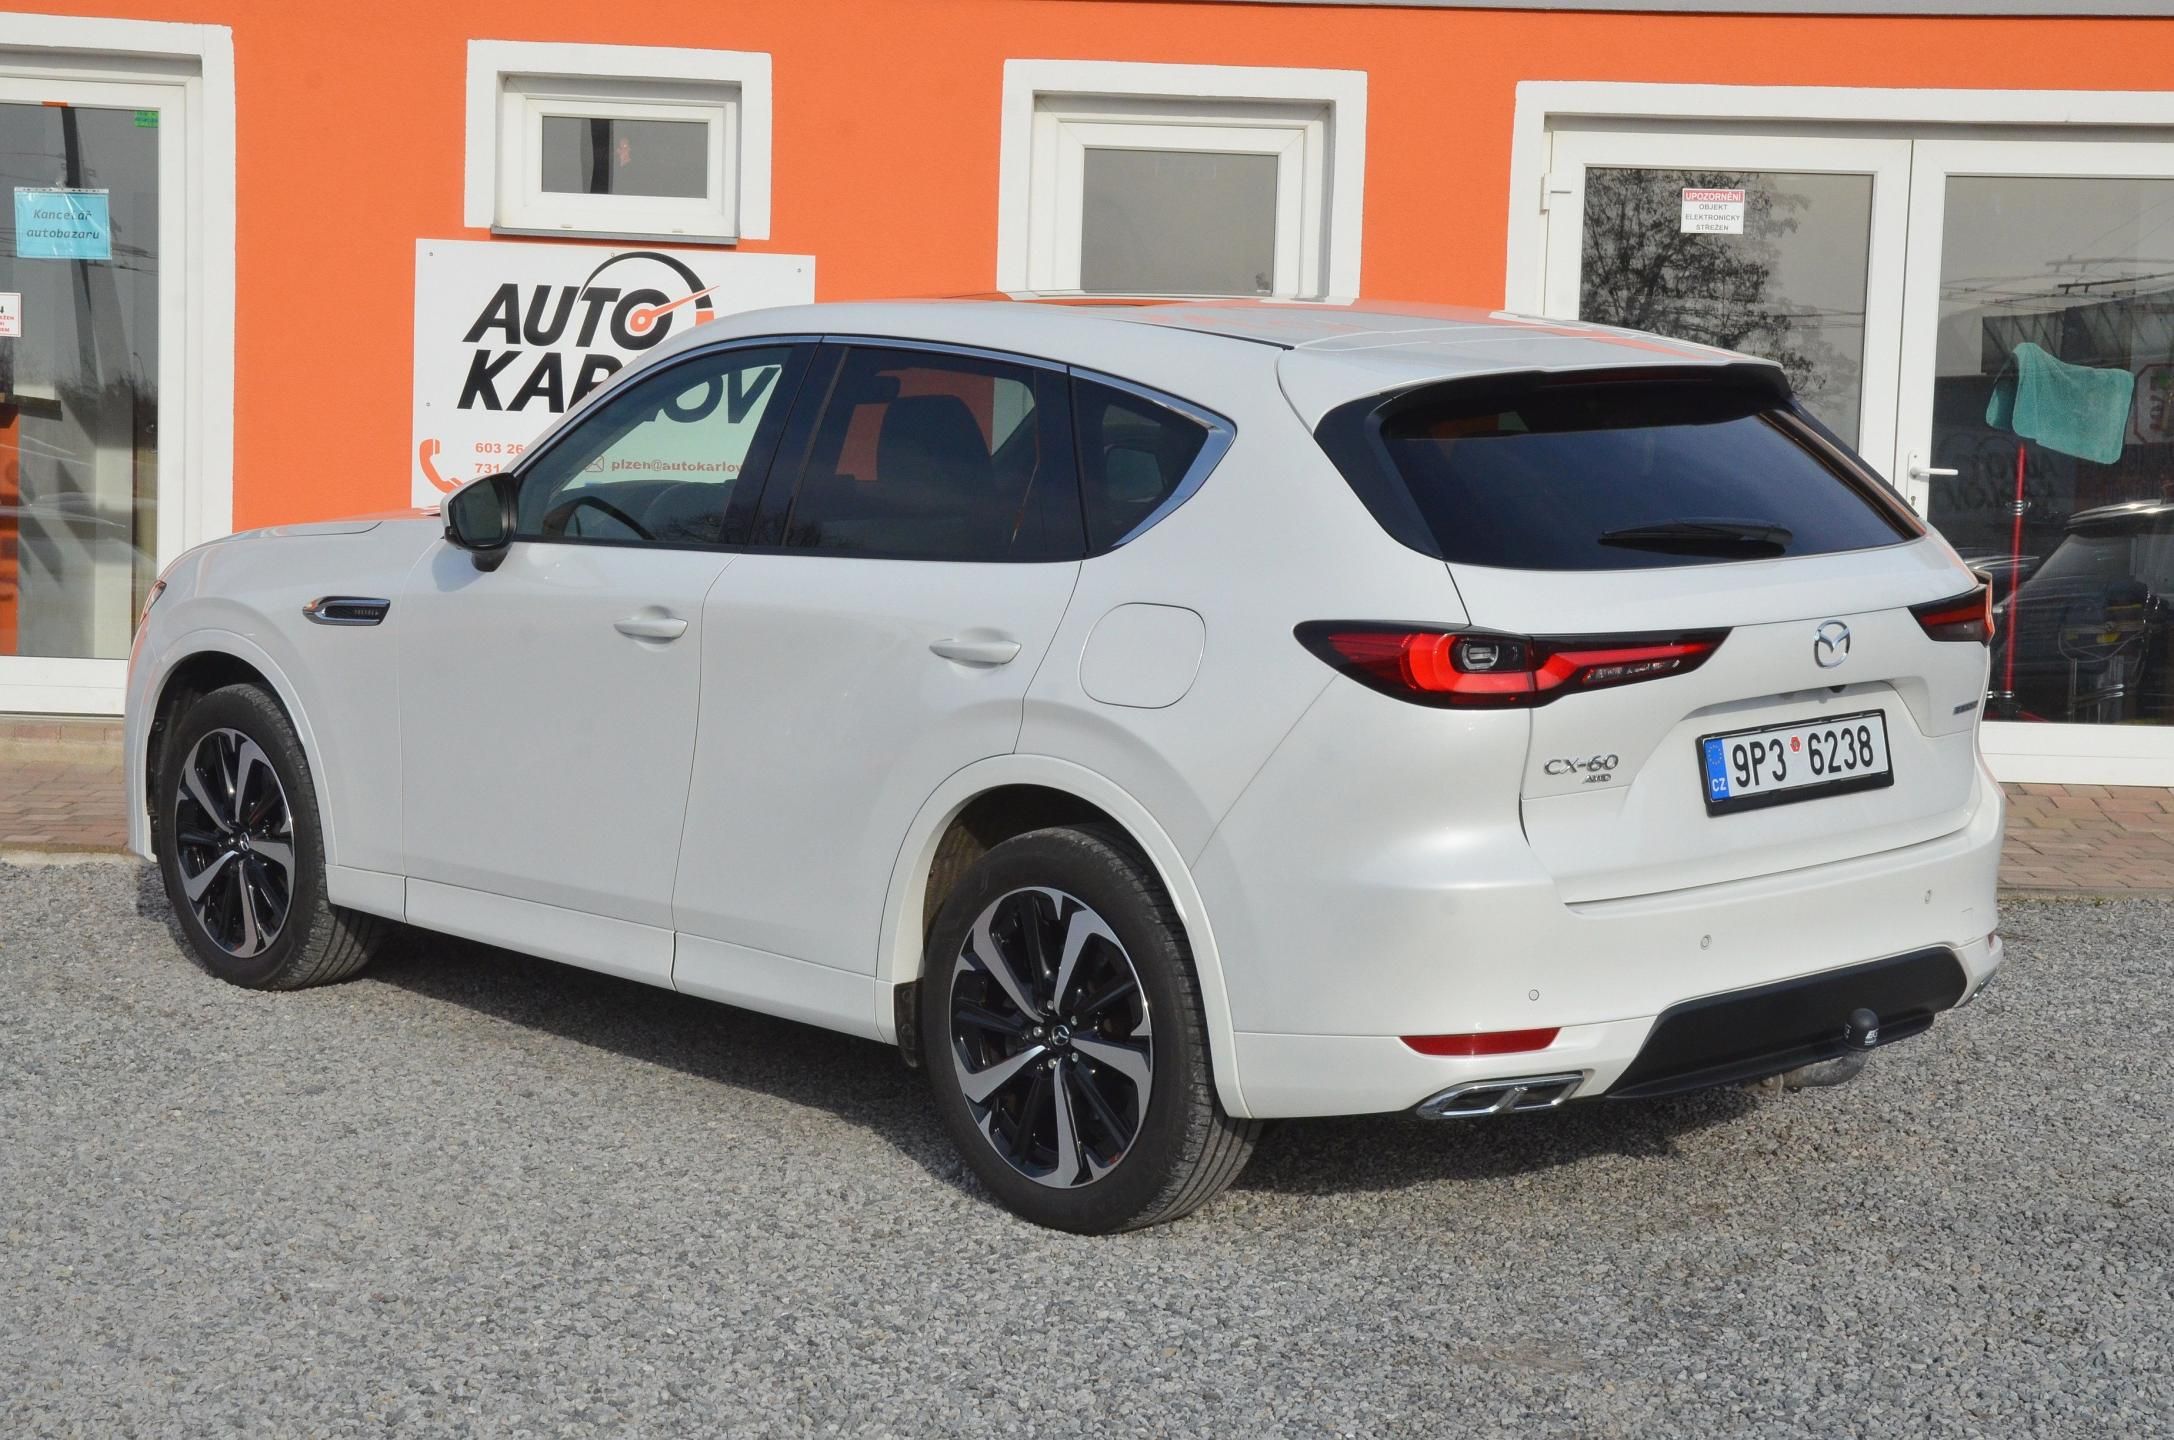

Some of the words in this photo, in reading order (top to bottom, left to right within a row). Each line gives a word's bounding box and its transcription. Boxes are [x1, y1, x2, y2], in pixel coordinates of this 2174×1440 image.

[1685, 191, 1741, 201] UPOZORNĚNÍ
[1685, 213, 1740, 221] ELEKTRONICKY
[26, 228, 100, 240] autobazaru
[462, 283, 673, 350] AUTO
[475, 442, 501, 454] 603
[475, 463, 500, 474] 731
[1732, 738, 1787, 788] 9P3
[1807, 725, 1874, 776] 6238
[1544, 754, 1619, 775] CX-60
[1712, 777, 1727, 792] CZ
